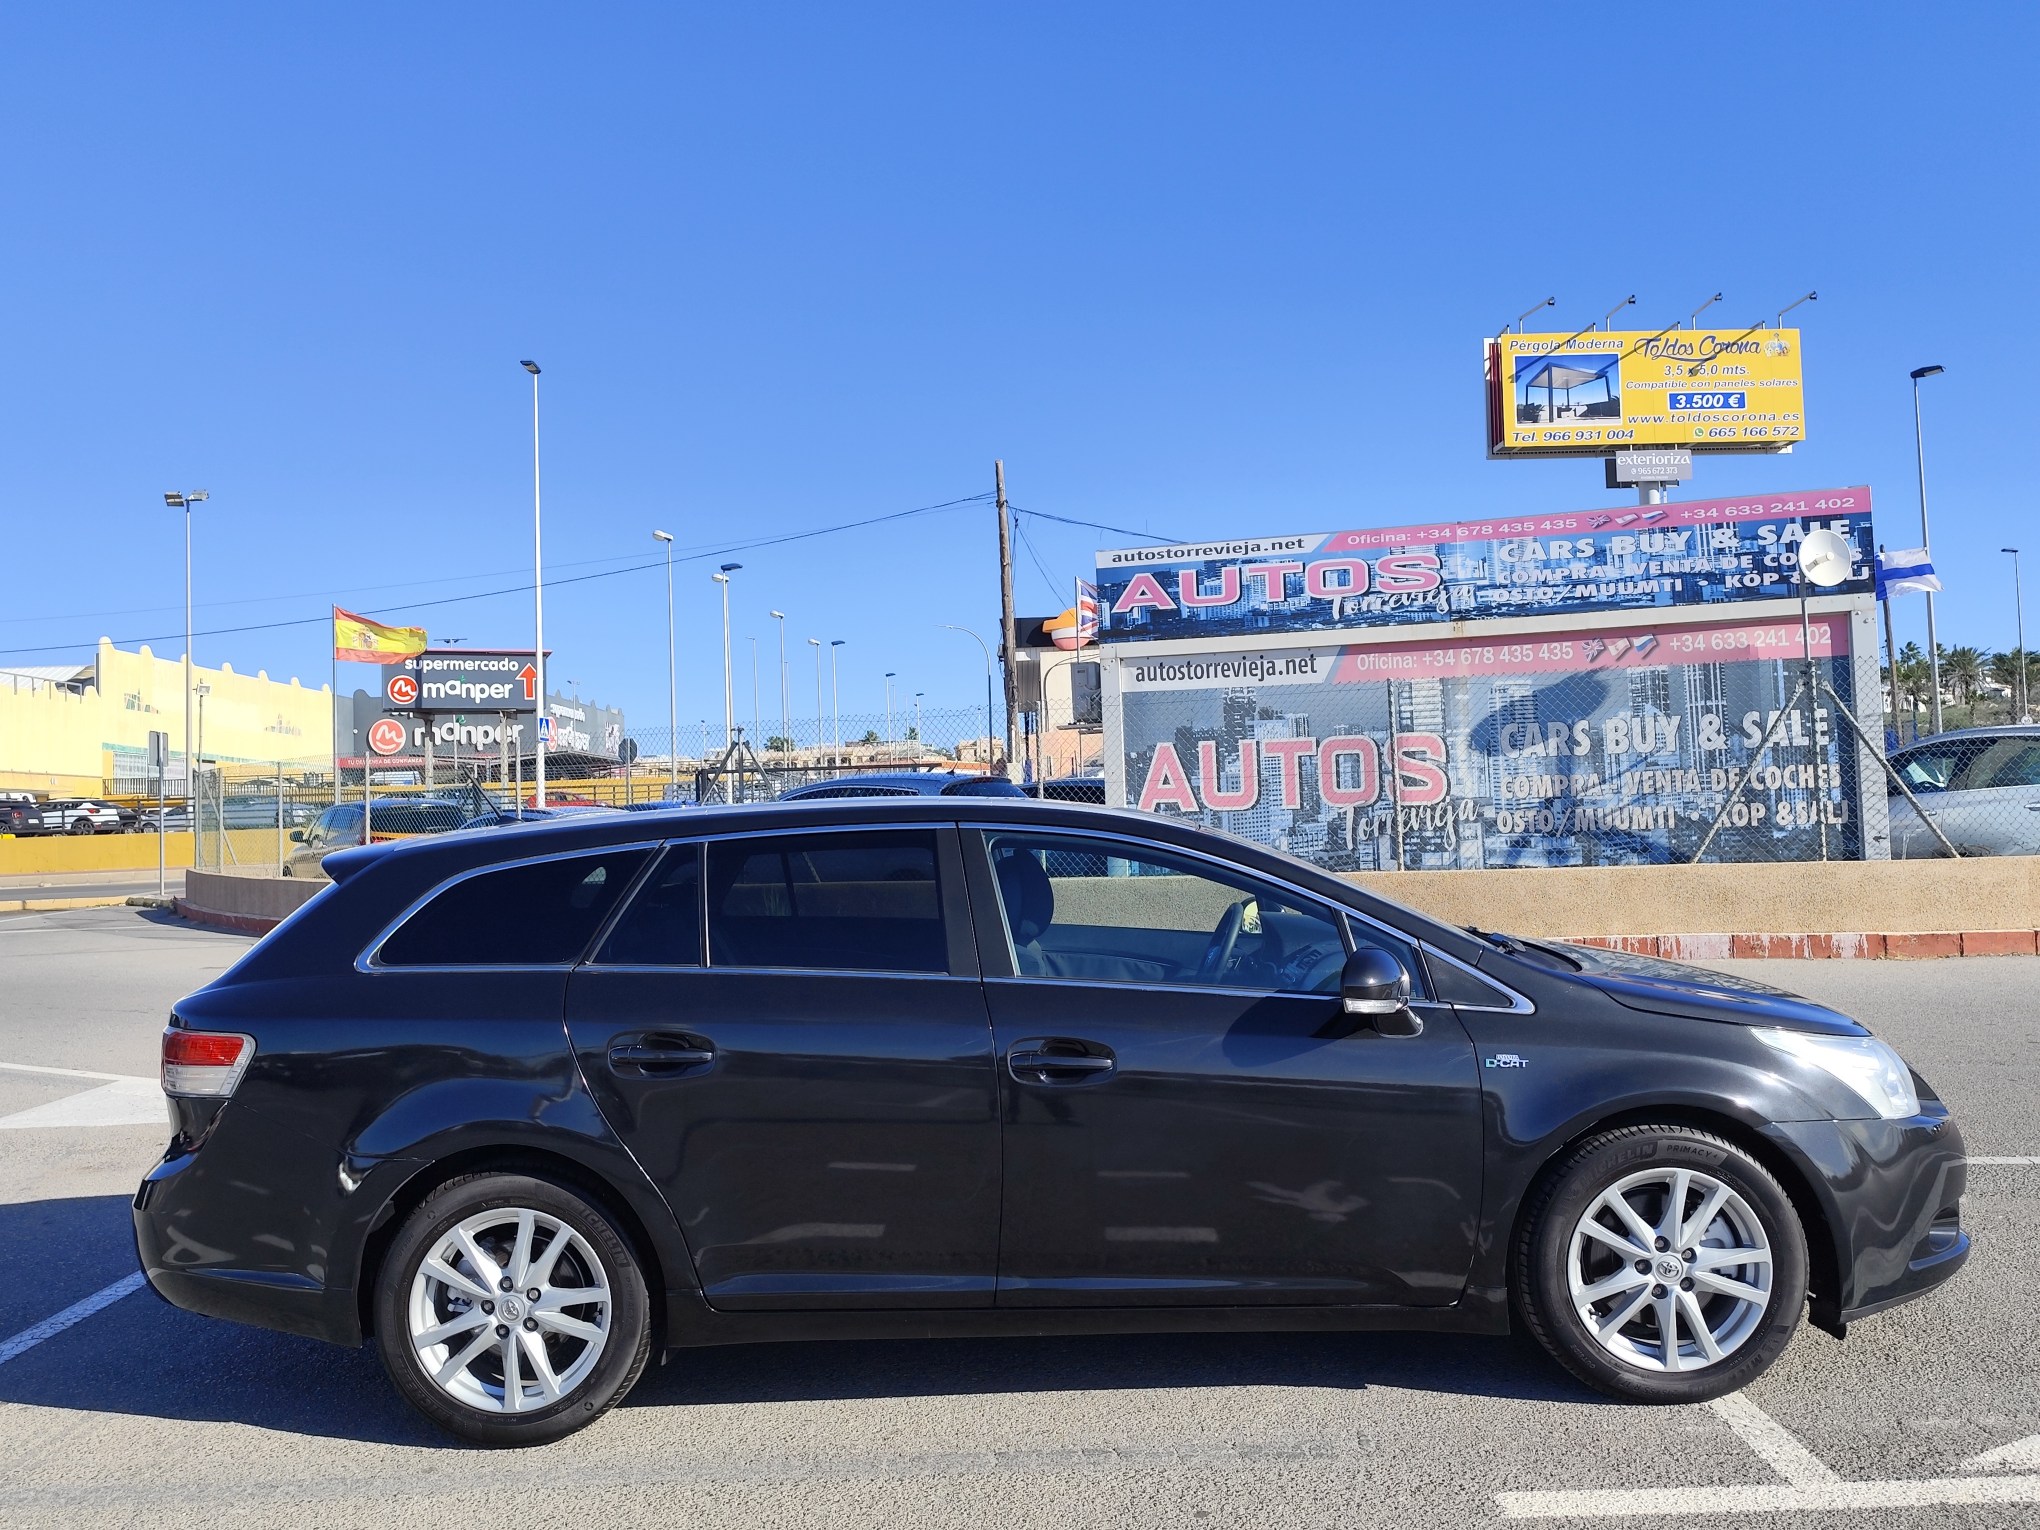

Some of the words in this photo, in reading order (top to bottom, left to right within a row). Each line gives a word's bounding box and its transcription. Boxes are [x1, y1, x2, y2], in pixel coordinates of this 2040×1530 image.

[1510, 340, 1560, 352] Pérgola
[1566, 339, 1623, 350] Moderna
[1700, 335, 1761, 355] Corona
[1664, 365, 1683, 377] 3,5
[1699, 364, 1718, 376] 5,0
[1722, 365, 1750, 375] mts.
[1626, 380, 1688, 390] Compatible
[1714, 379, 1755, 389] paneles
[1759, 378, 1798, 387] solares
[1675, 394, 1723, 409] 3.500
[1728, 394, 1740, 408] €
[1628, 412, 1799, 424] www.toldoscorona.es
[1512, 432, 1538, 442] Tel.
[1543, 431, 1571, 441] 966
[1575, 430, 1601, 440] 931
[1606, 429, 1634, 440] 004
[1708, 427, 1736, 437] 665
[1742, 427, 1767, 437] 166
[1772, 426, 1799, 436] 572
[1617, 453, 1690, 465] exterioriza
[1637, 467, 1651, 475] 965
[1666, 466, 1678, 474] 373
[1680, 507, 1719, 520] +34
[1724, 504, 1764, 517] 633
[1770, 501, 1809, 513] 241
[1815, 497, 1855, 509] 402
[1347, 532, 1411, 545] Oficina:
[1416, 528, 1451, 540] +34
[1457, 525, 1493, 537] 678
[1499, 522, 1535, 533] 435
[1540, 518, 1578, 530] 435
[1112, 538, 1305, 563] autostorrevieja.net
[1500, 538, 1595, 562] CARS
[1611, 531, 1692, 555] BUY
[1711, 528, 1741, 549] &
[1500, 565, 1606, 584] COMPRA
[1630, 557, 1713, 576] VENTA
[1722, 555, 1753, 570] DE
[1725, 570, 1780, 588] KÖP
[1111, 553, 1446, 614] AUTOS
[1331, 583, 1476, 620] Torrevieja
[1669, 634, 1706, 652] +34
[1711, 632, 1749, 650] 633
[1753, 628, 1790, 647] 241
[1794, 626, 1831, 644] 402
[404, 657, 519, 673] supermercado
[1357, 653, 1417, 670] Oficina:
[1422, 650, 1455, 666] +34
[1460, 647, 1494, 664] 678
[1499, 645, 1534, 662] 435
[1538, 642, 1574, 660] 435
[1135, 654, 1317, 682] autostorrevieja.net
[422, 680, 513, 704] manper
[1501, 719, 1592, 759] CARS
[1606, 715, 1682, 754] BUY
[1700, 713, 1728, 751] &
[1743, 708, 1829, 748] SALE
[1136, 732, 1449, 812] AUTOS
[1623, 769, 1702, 795] VENTA
[1751, 763, 1841, 790] COCHES
[1339, 796, 1480, 850] Torrevieja
[1485, 1058, 1529, 1068] D-CAT
[1666, 1144, 1711, 1158] PRIMACY
